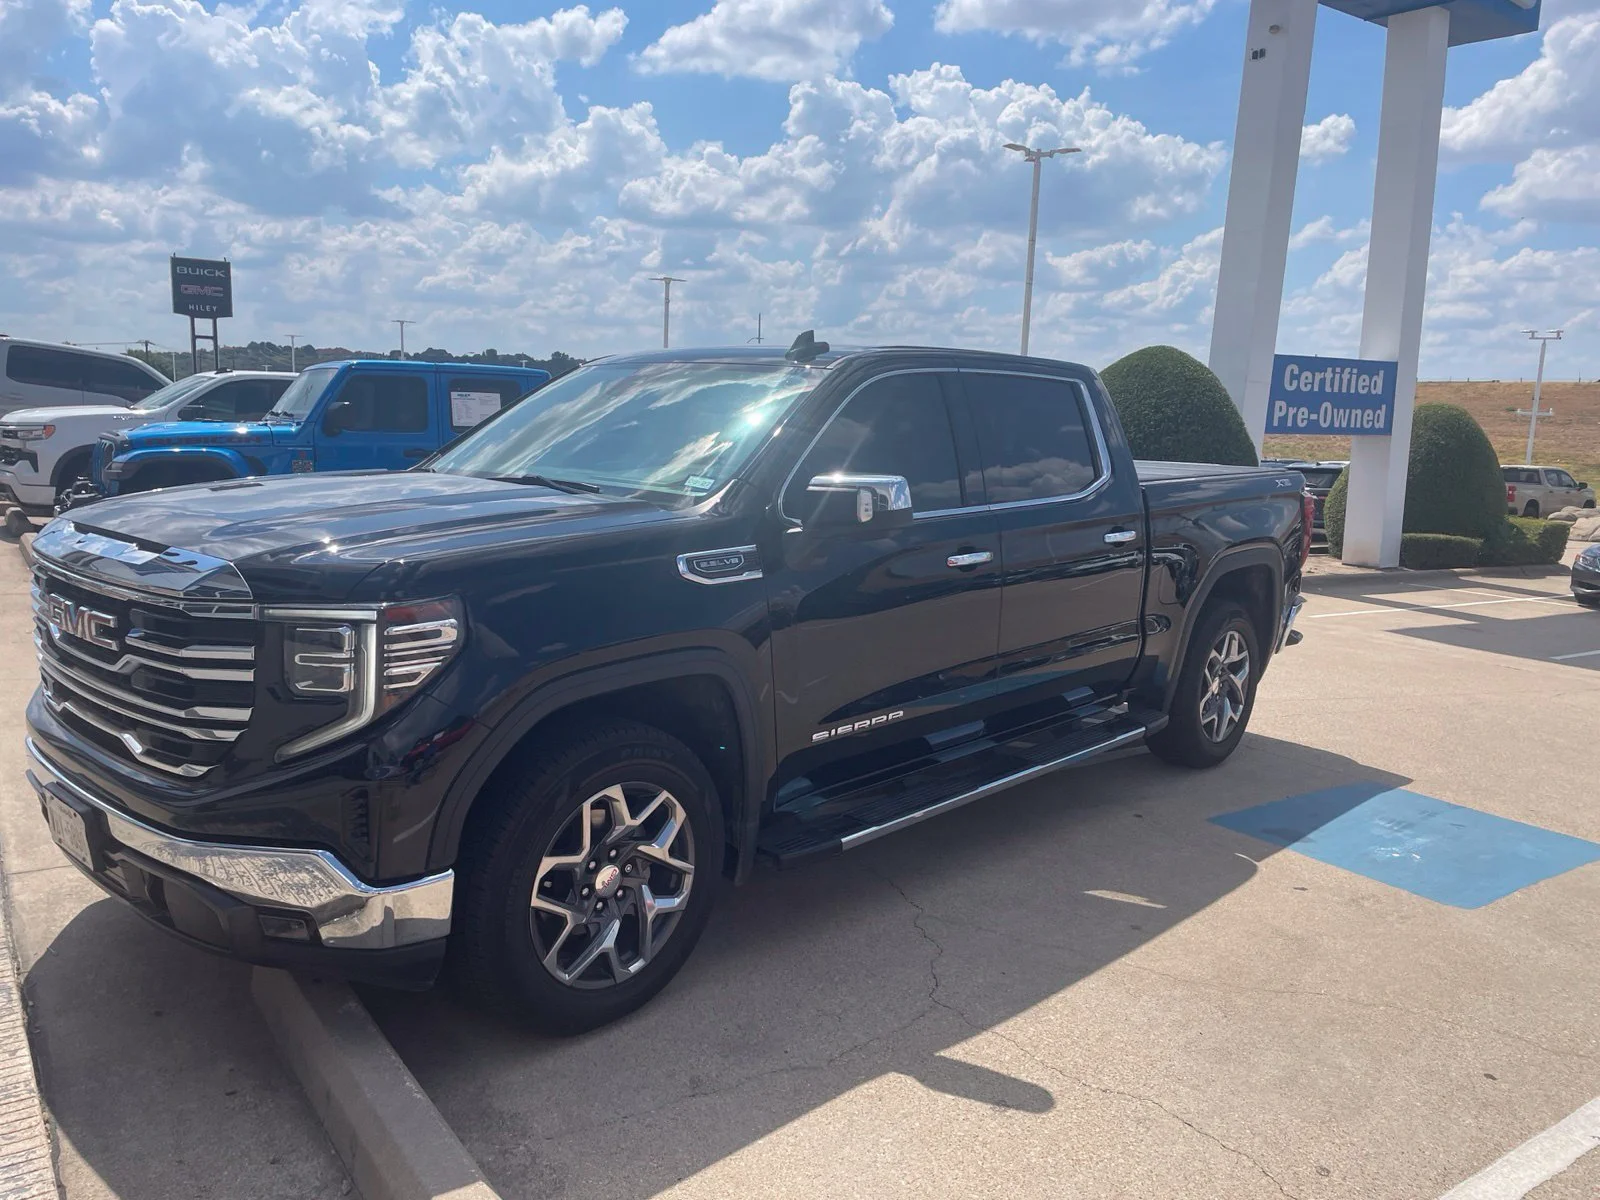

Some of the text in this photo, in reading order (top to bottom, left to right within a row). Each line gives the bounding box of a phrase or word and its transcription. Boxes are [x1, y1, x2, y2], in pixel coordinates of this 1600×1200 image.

[176, 266, 226, 278] BUICK
[181, 284, 224, 297] GMC
[188, 304, 217, 312] HILEY
[1283, 363, 1385, 395] Certified
[1272, 400, 1387, 429] Pre-Owned
[48, 592, 119, 652] GMC
[811, 710, 904, 742] SIERRA
